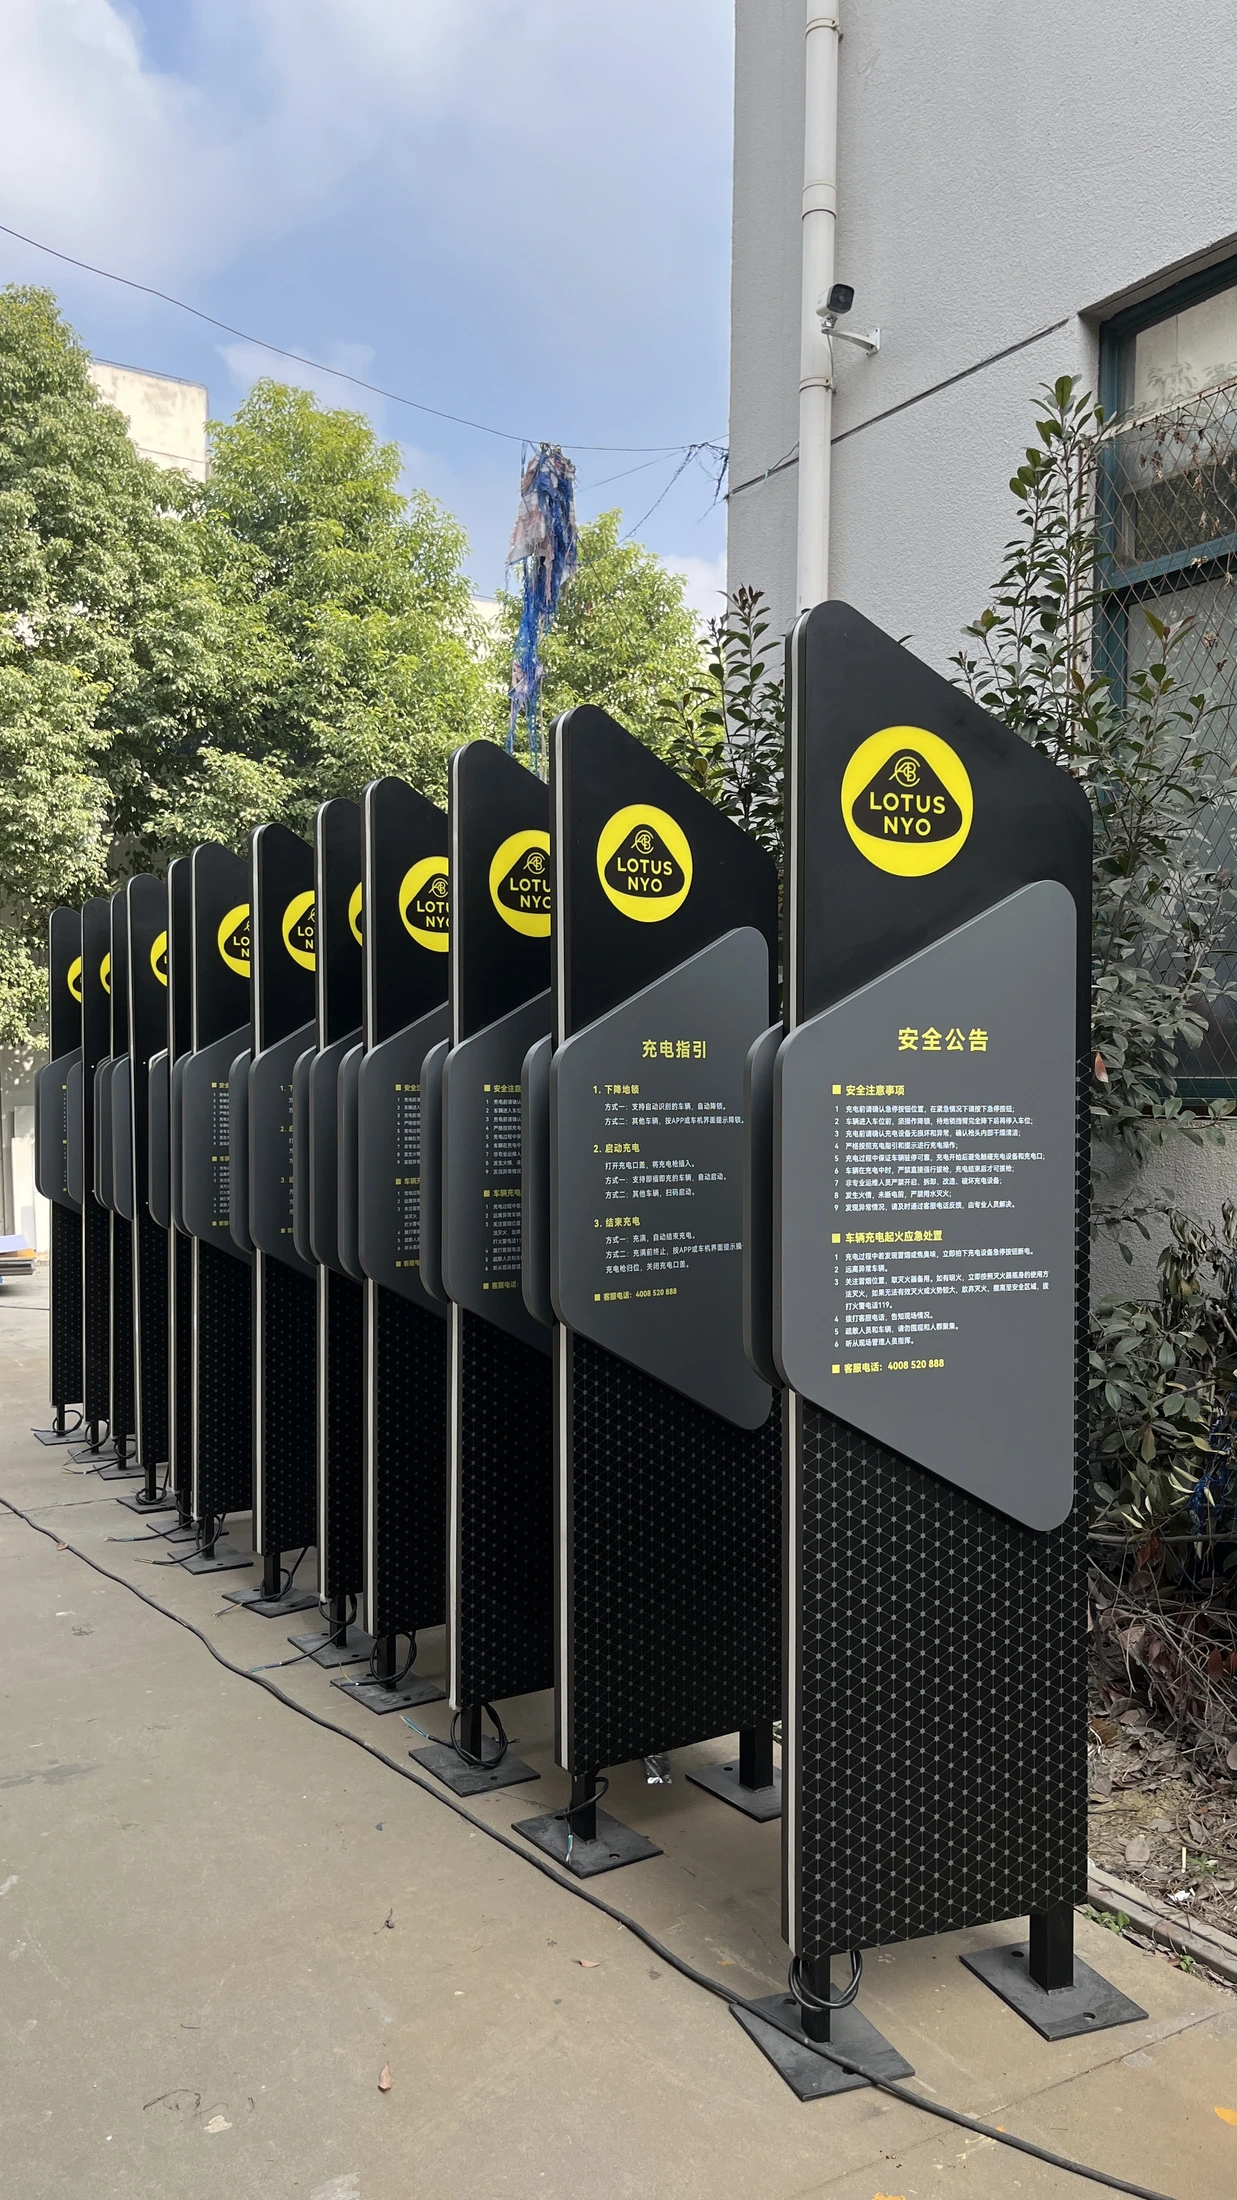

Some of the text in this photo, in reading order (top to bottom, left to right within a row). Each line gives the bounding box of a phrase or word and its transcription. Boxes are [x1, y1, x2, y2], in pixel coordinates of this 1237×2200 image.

[869, 791, 946, 815] LOTUS
[883, 816, 932, 836] NYO
[617, 856, 673, 876] LOTUS
[510, 877, 550, 892] LOTU
[627, 876, 663, 893] NYO
[416, 900, 449, 913] LOT
[897, 1026, 989, 1052] 安全公告
[642, 1039, 707, 1058] 充电指引
[604, 1085, 639, 1095] 下降地锁
[846, 1085, 905, 1096] 安全注意事项
[605, 1143, 640, 1154] 启动充电
[605, 1216, 641, 1228] 结束充电
[845, 1230, 942, 1244] 车辆充电起火应急处置
[635, 1290, 651, 1298] 4008
[653, 1289, 664, 1297] 520
[665, 1288, 677, 1296] 888
[888, 1361, 908, 1371] 4008
[911, 1360, 926, 1369] 520
[928, 1359, 944, 1368] 888
